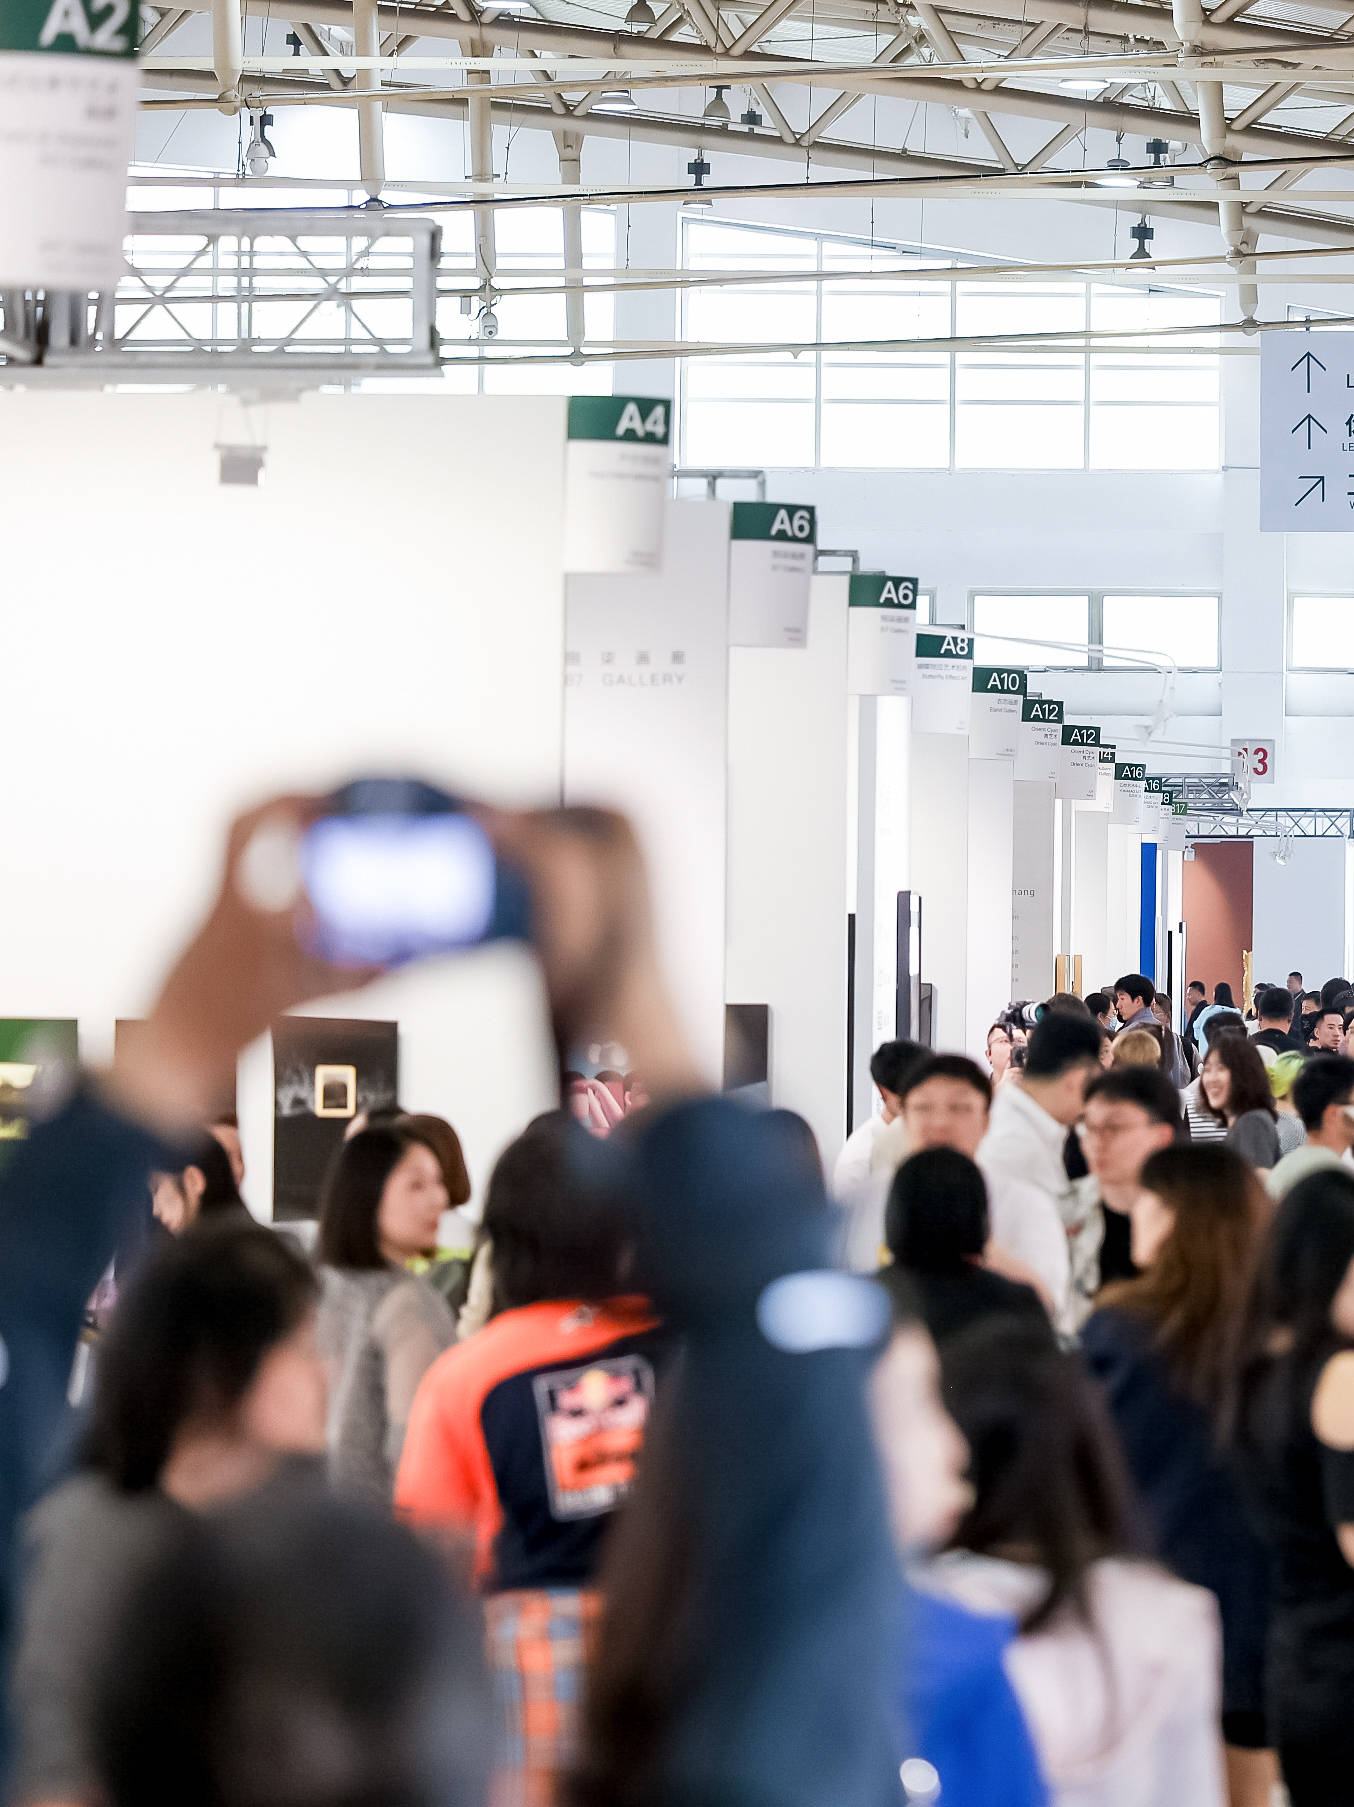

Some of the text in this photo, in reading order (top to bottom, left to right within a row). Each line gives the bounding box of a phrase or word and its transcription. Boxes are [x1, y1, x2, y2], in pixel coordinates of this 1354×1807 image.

[38, 0, 130, 49] A2
[615, 401, 667, 439] A4
[769, 508, 811, 538] A6
[879, 580, 914, 605] A6
[940, 635, 969, 655] A8
[601, 672, 686, 688] GALLERY
[986, 672, 1020, 691] A10
[1030, 703, 1060, 720] A12
[1069, 728, 1096, 744] A12
[1238, 747, 1268, 776] 3
[1121, 765, 1143, 779] A16
